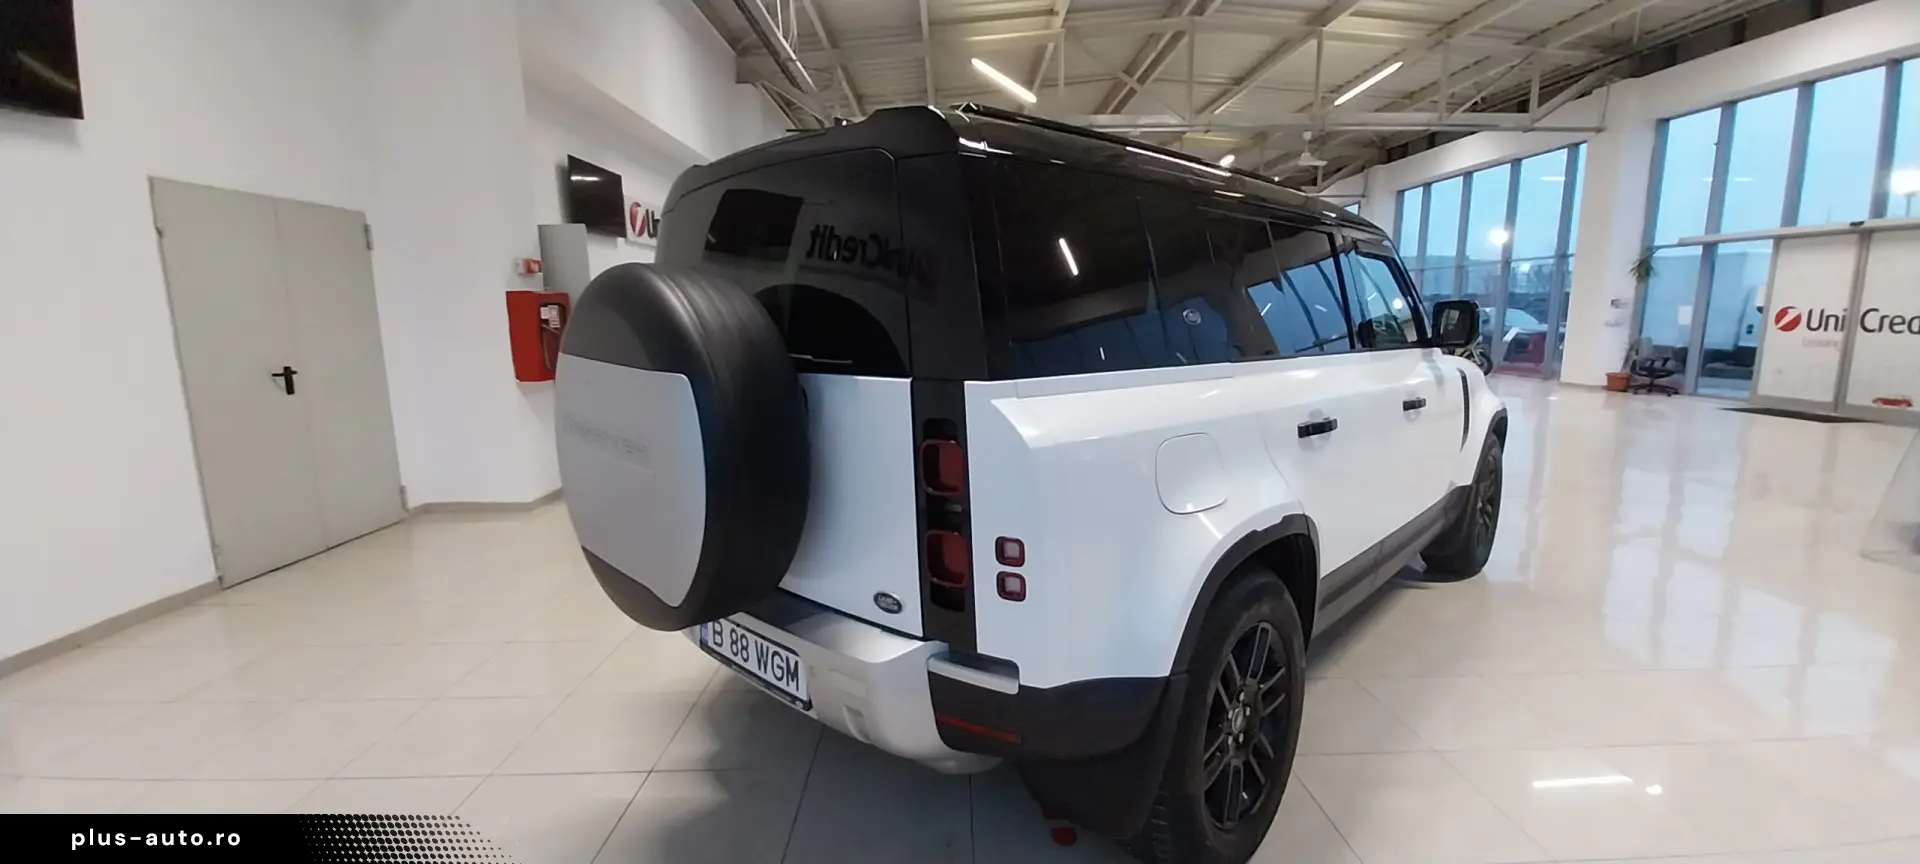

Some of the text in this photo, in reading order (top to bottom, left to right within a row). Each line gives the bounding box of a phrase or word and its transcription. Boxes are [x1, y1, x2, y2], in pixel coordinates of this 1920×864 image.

[1806, 308, 1848, 332] Uni
[713, 620, 799, 692] B 88 WGM
